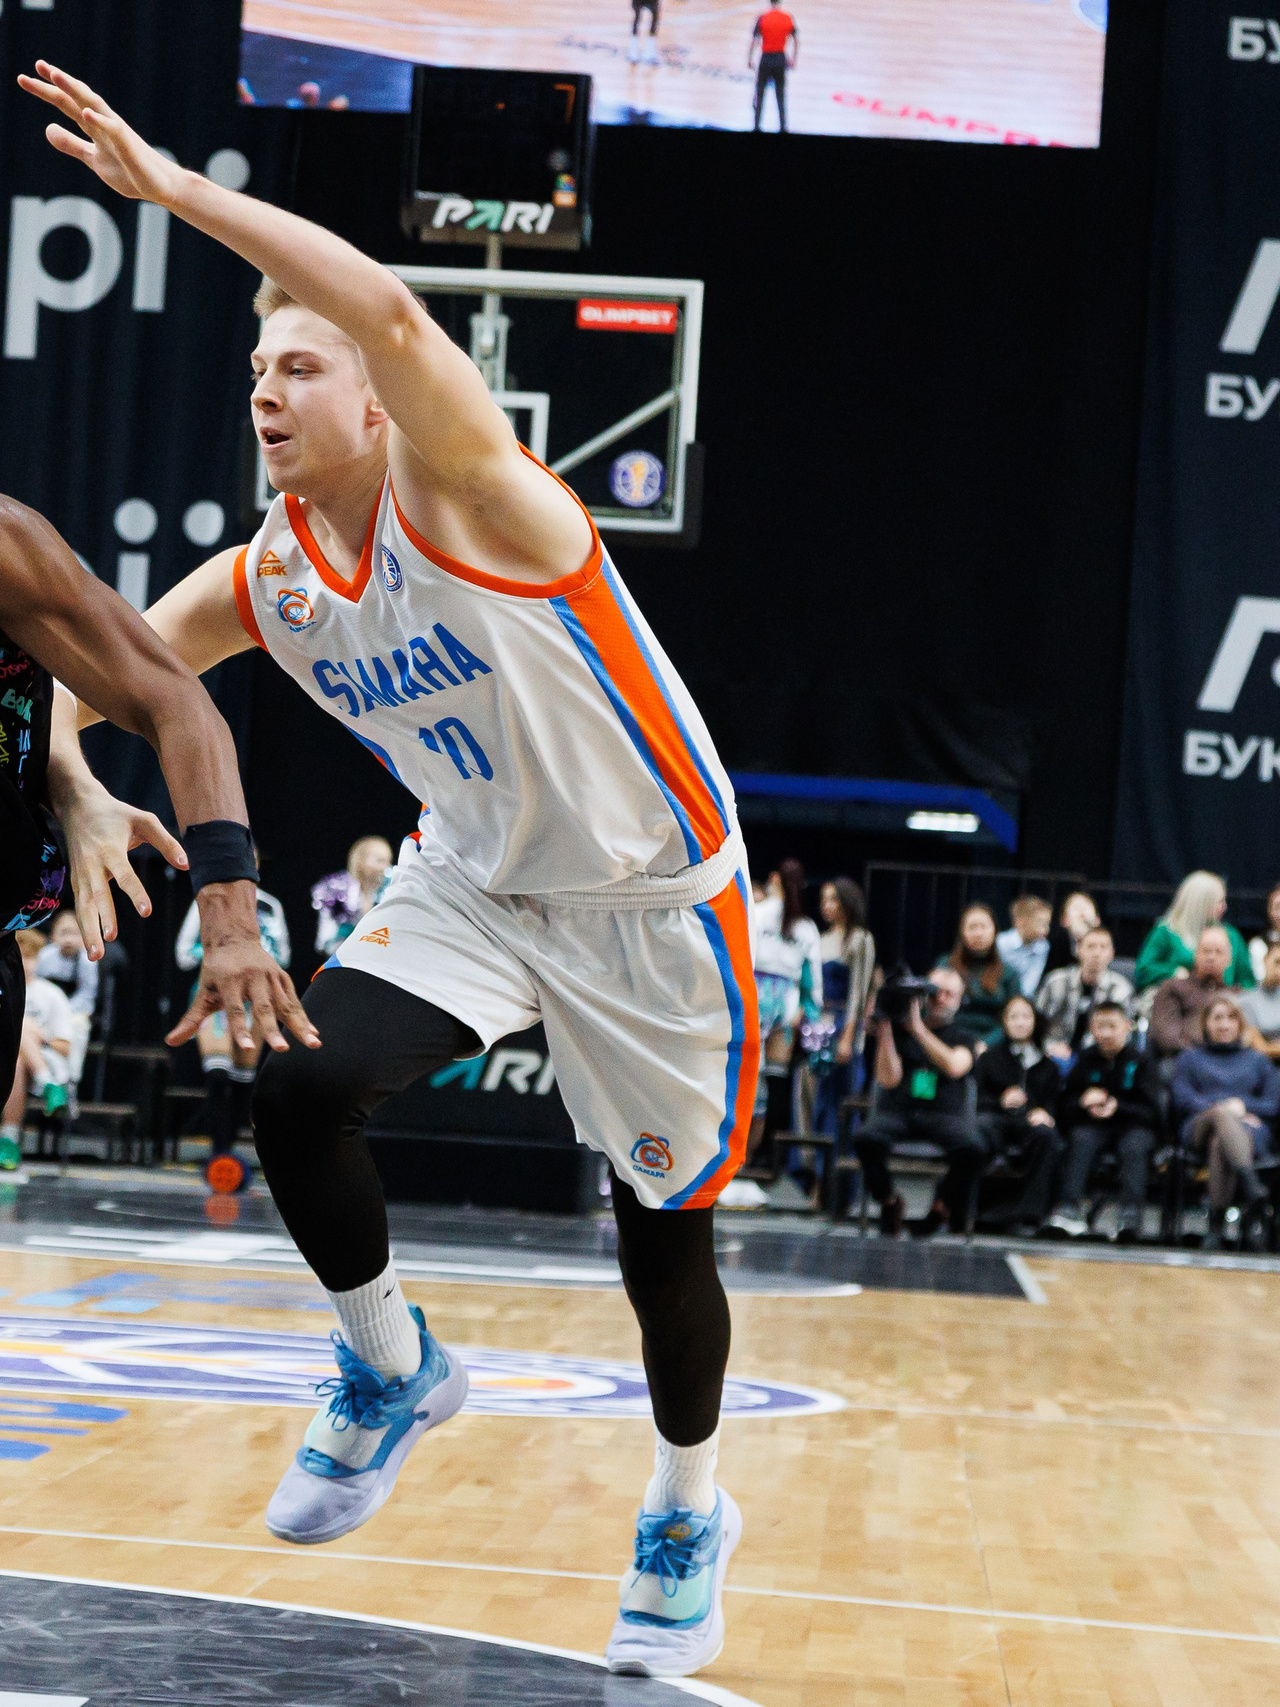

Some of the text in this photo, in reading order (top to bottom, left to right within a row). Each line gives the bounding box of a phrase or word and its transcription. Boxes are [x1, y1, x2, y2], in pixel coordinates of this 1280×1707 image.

[431, 199, 554, 234] PARI
[257, 564, 287, 579] PEAK
[418, 716, 495, 783] 10
[359, 935, 390, 949] PEAK
[430, 1048, 556, 1096] ARI
